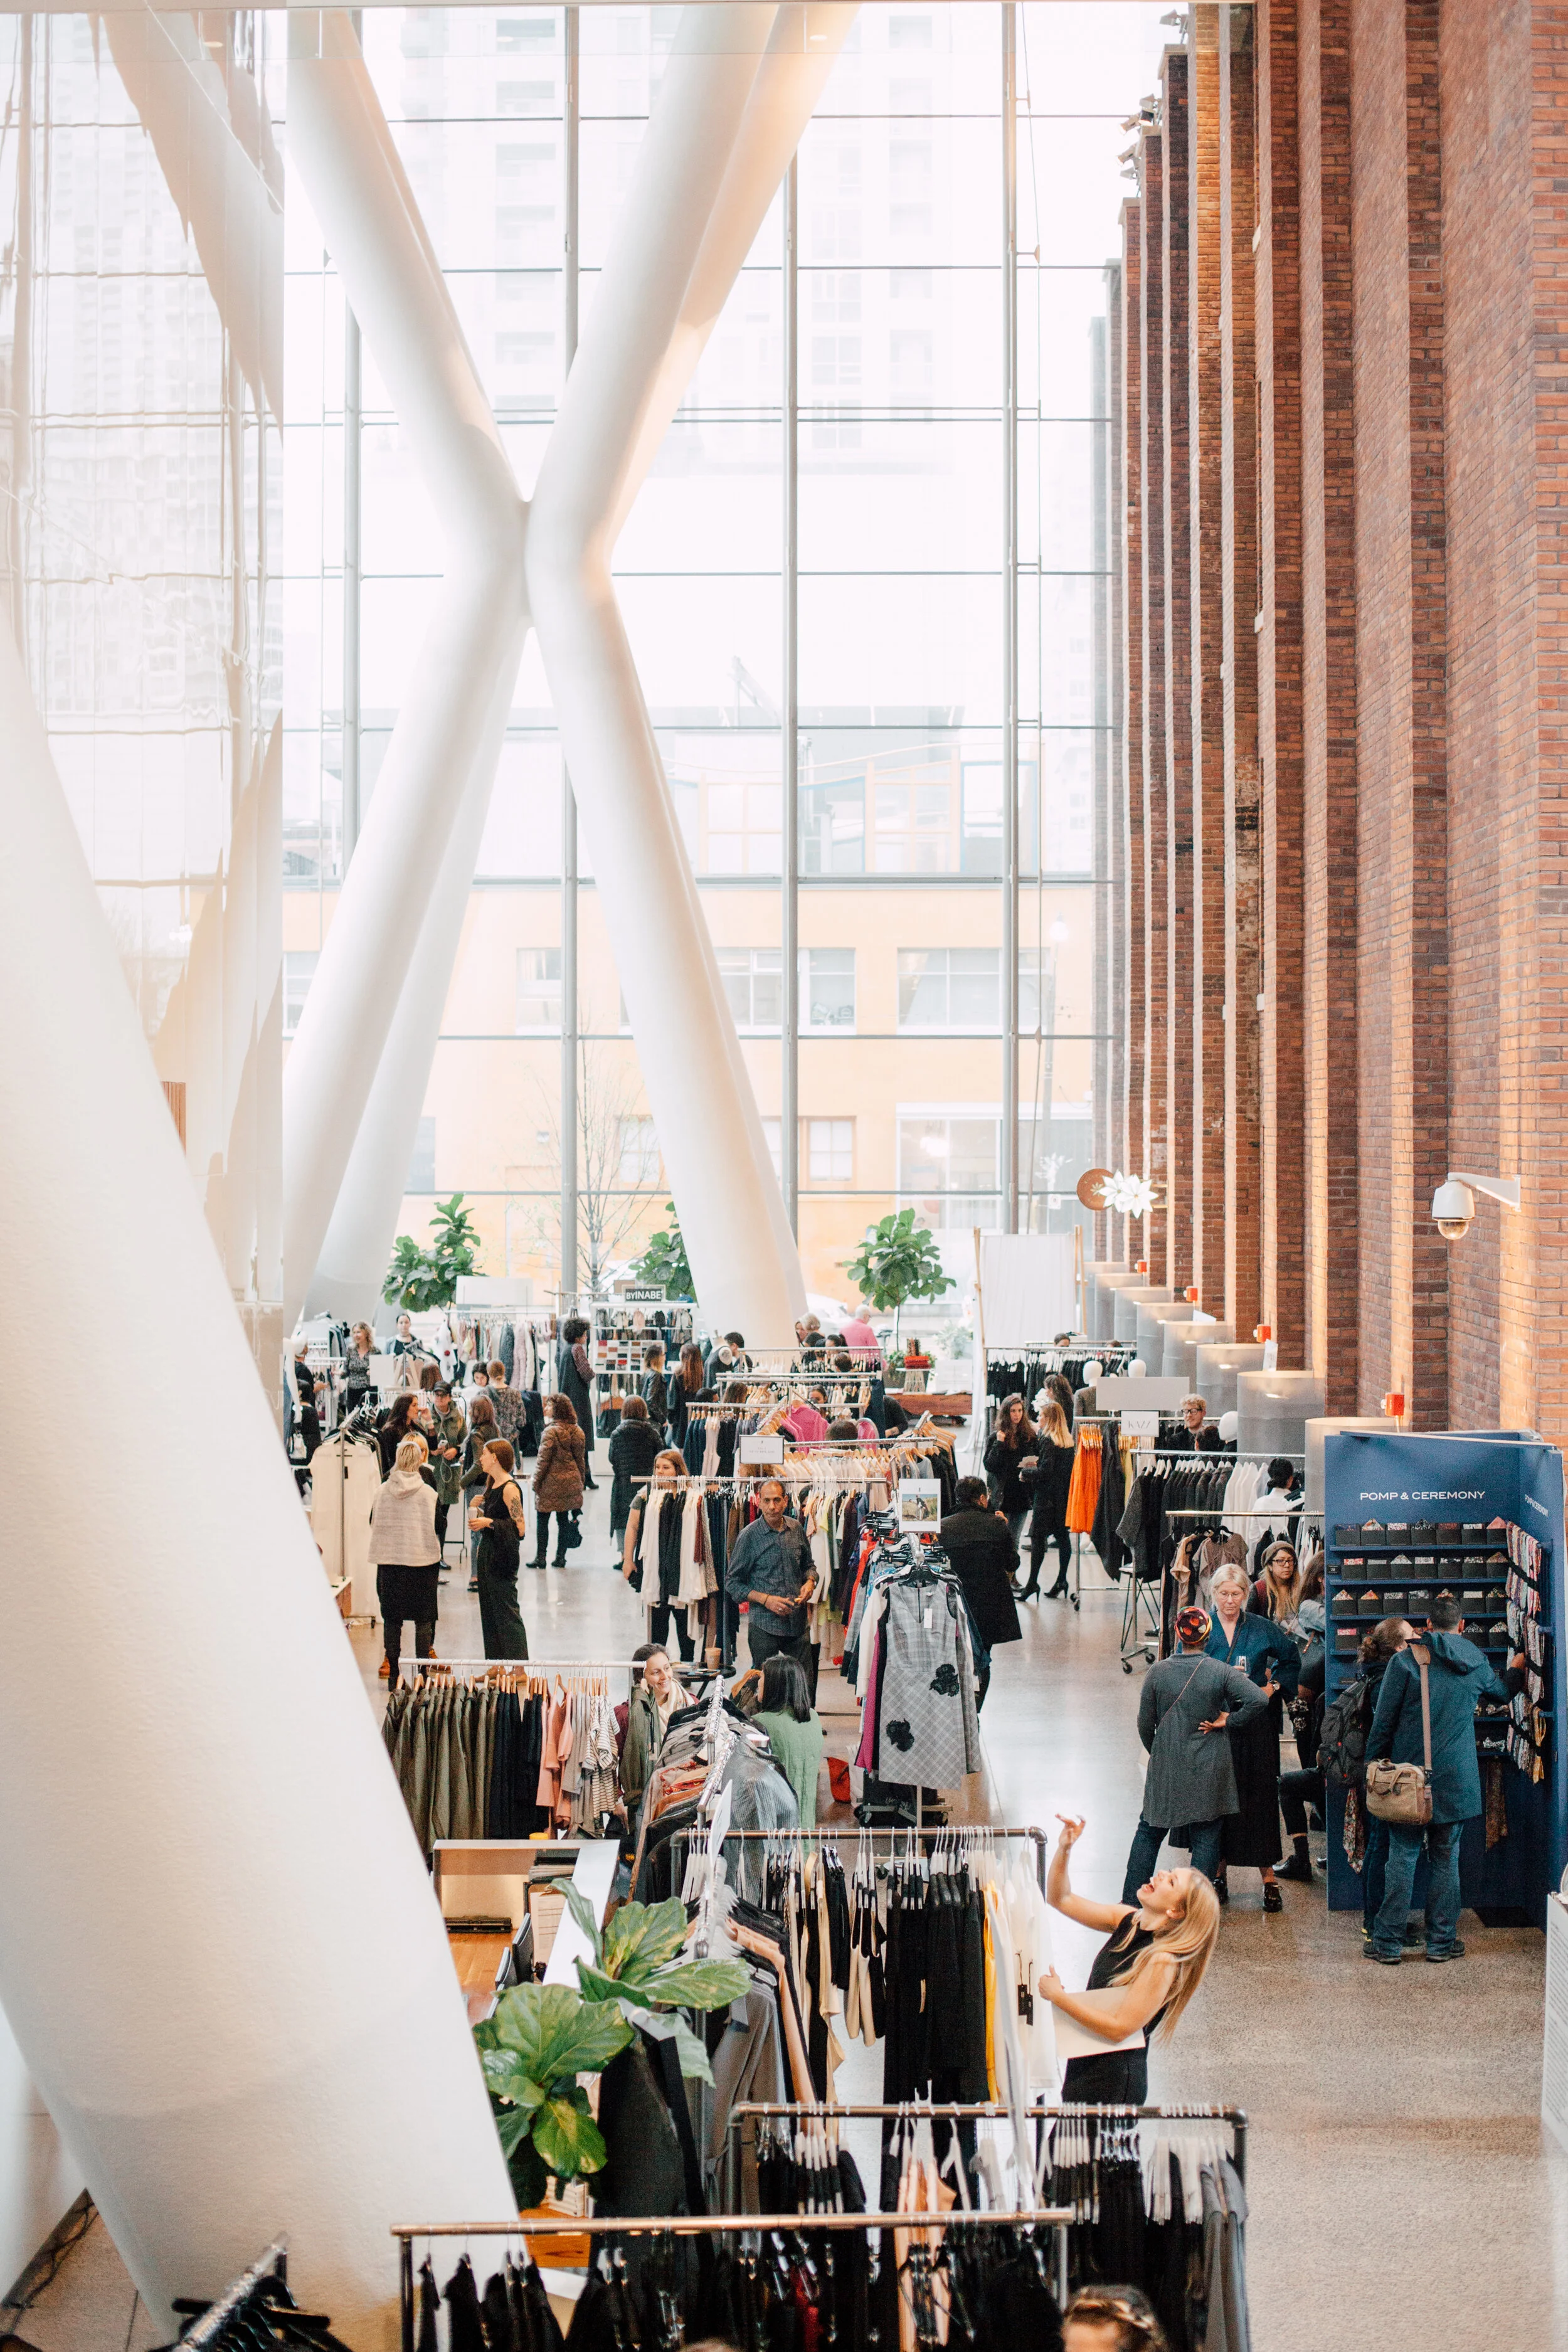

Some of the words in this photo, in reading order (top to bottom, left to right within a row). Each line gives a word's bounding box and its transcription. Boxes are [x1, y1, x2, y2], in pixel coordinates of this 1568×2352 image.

[1360, 1492, 1399, 1501] POMP
[1400, 1491, 1409, 1500] &
[1411, 1491, 1486, 1500] CEREMONY
